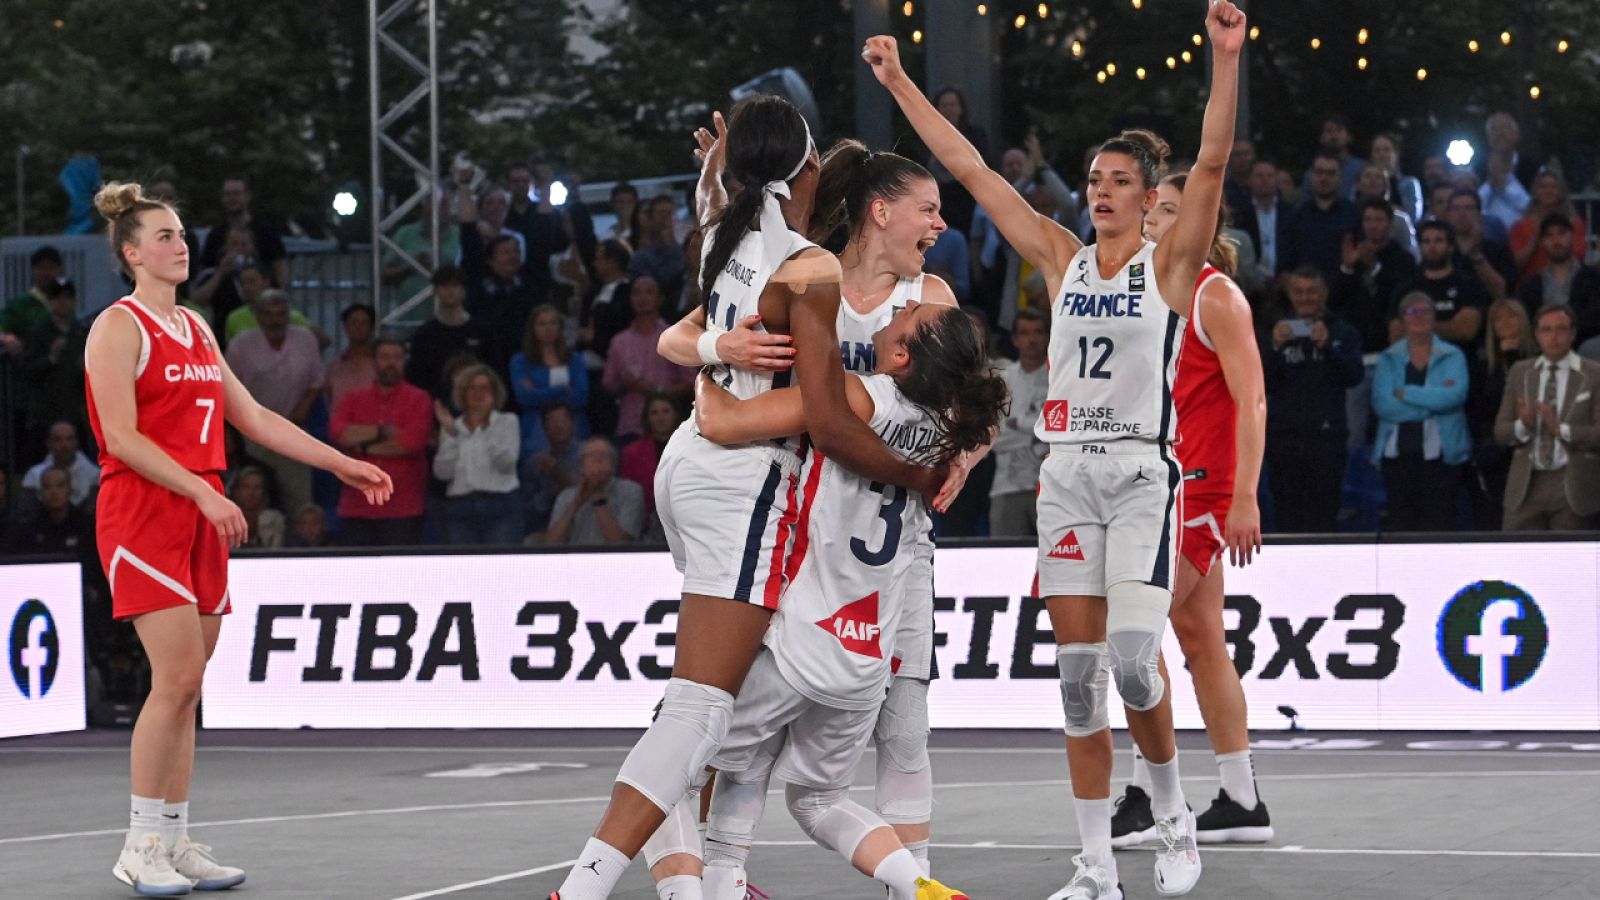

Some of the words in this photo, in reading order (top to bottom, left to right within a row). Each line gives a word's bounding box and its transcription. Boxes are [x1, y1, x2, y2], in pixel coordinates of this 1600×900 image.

[1060, 292, 1143, 318] FRANCE
[165, 364, 223, 382] CANAD
[1079, 336, 1114, 379] 12
[196, 399, 215, 444] 7
[1082, 445, 1107, 454] FRA
[850, 481, 907, 566] 3
[1050, 545, 1080, 555] MAIF
[249, 602, 481, 682] FIBA
